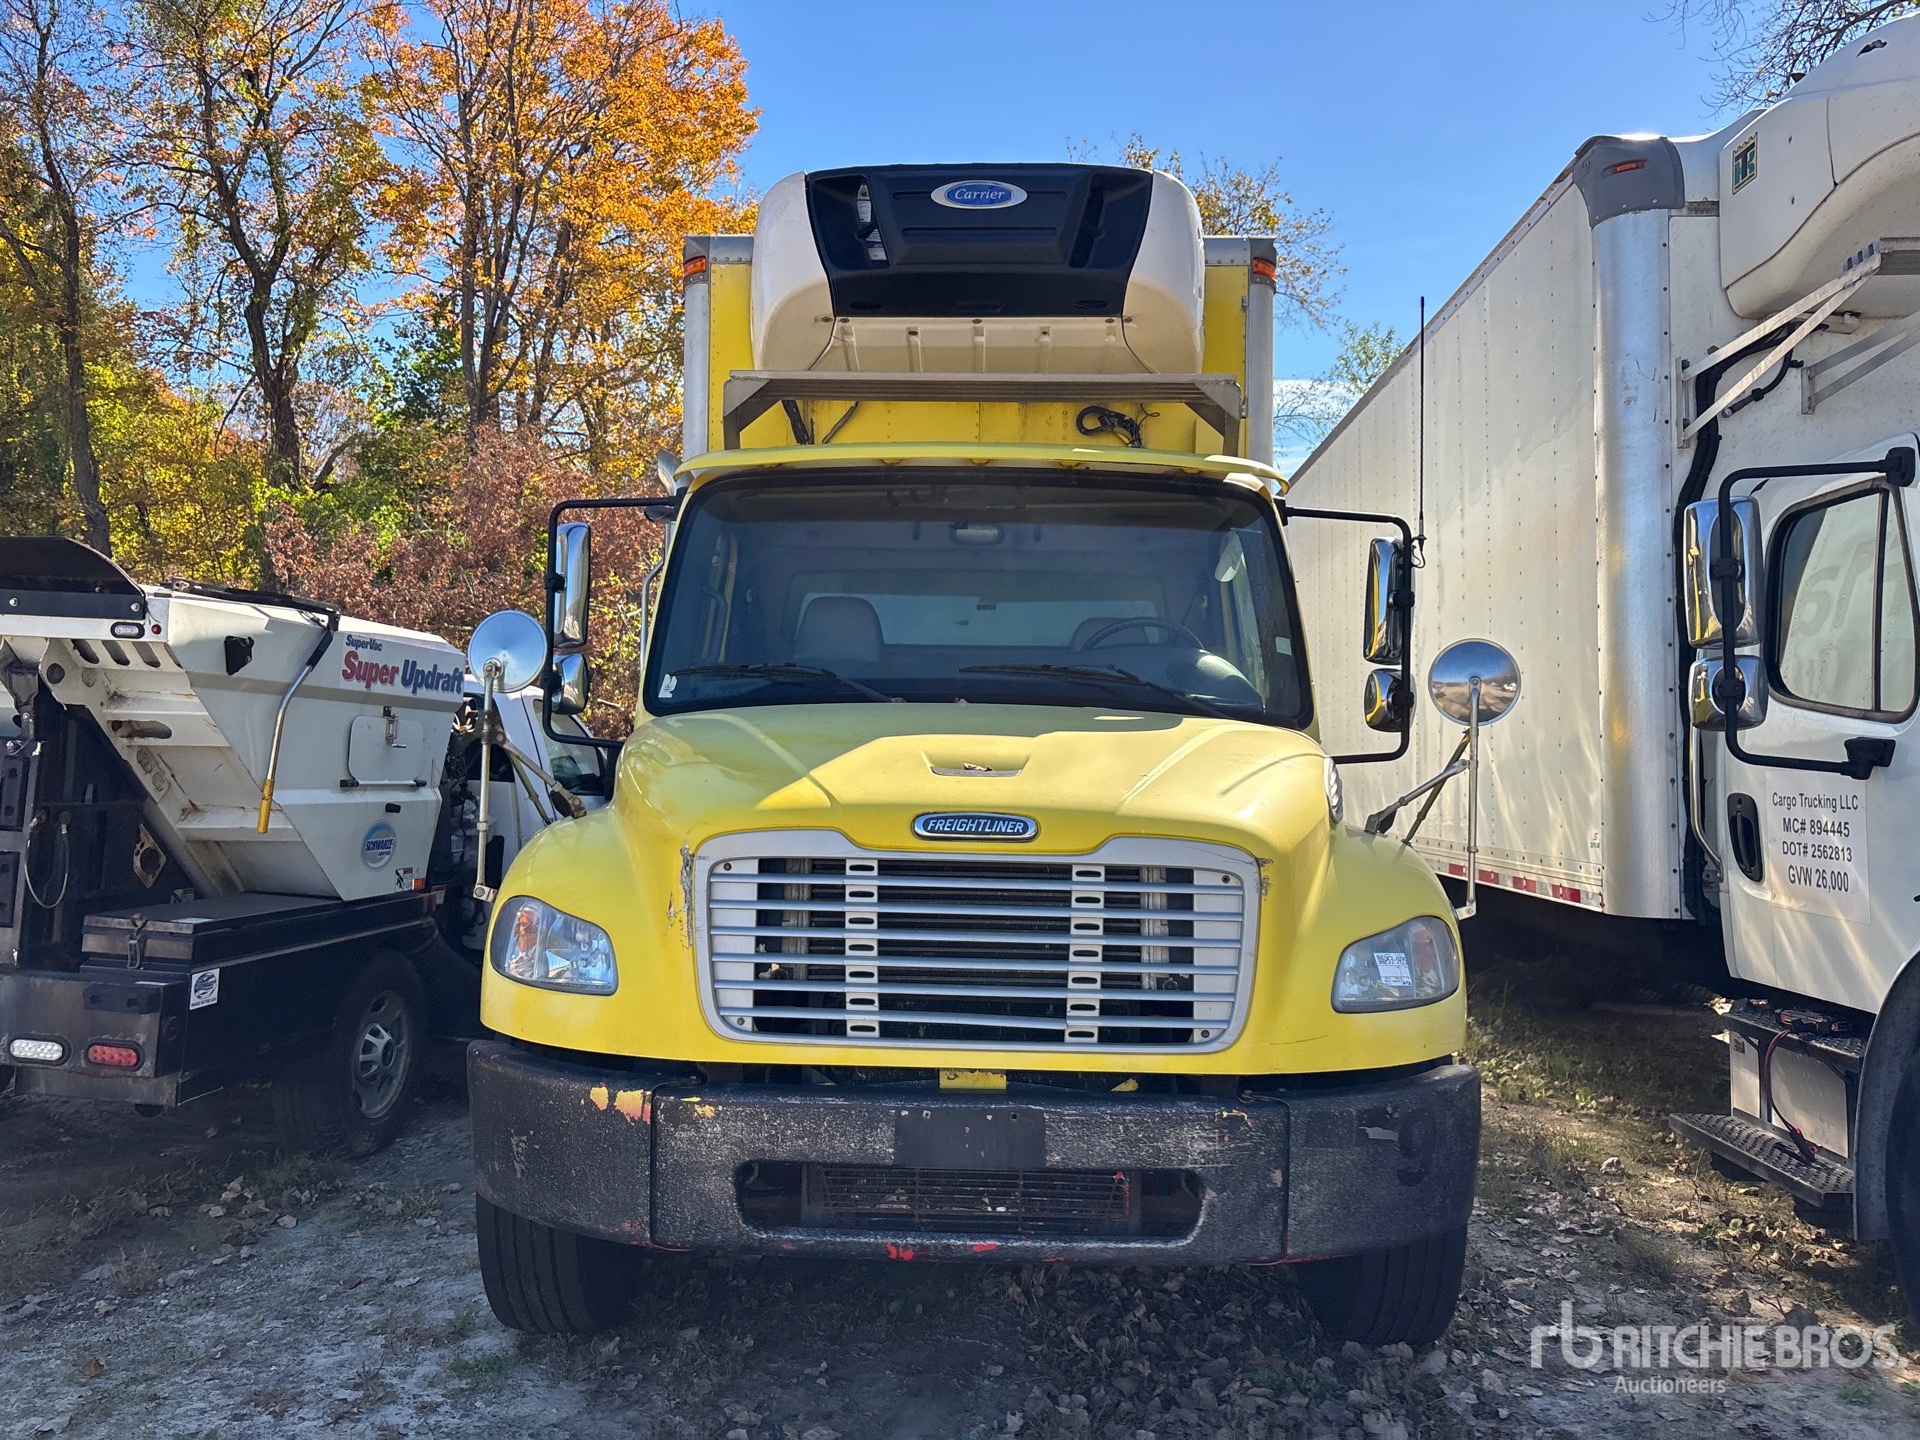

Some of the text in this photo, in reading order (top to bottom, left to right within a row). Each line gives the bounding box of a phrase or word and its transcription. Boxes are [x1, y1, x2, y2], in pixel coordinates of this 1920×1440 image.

[954, 188, 1005, 200] Carrier
[345, 634, 383, 652] SuperVac
[341, 650, 464, 695] Super Updraft
[1772, 791, 1859, 813] Cargo Trucking LLC
[926, 818, 1024, 833] FREIGHTLINER
[1782, 817, 1850, 838] MC# 894445
[1782, 840, 1852, 862] DOT# 2562813
[1787, 864, 1849, 893] GVW 26,000
